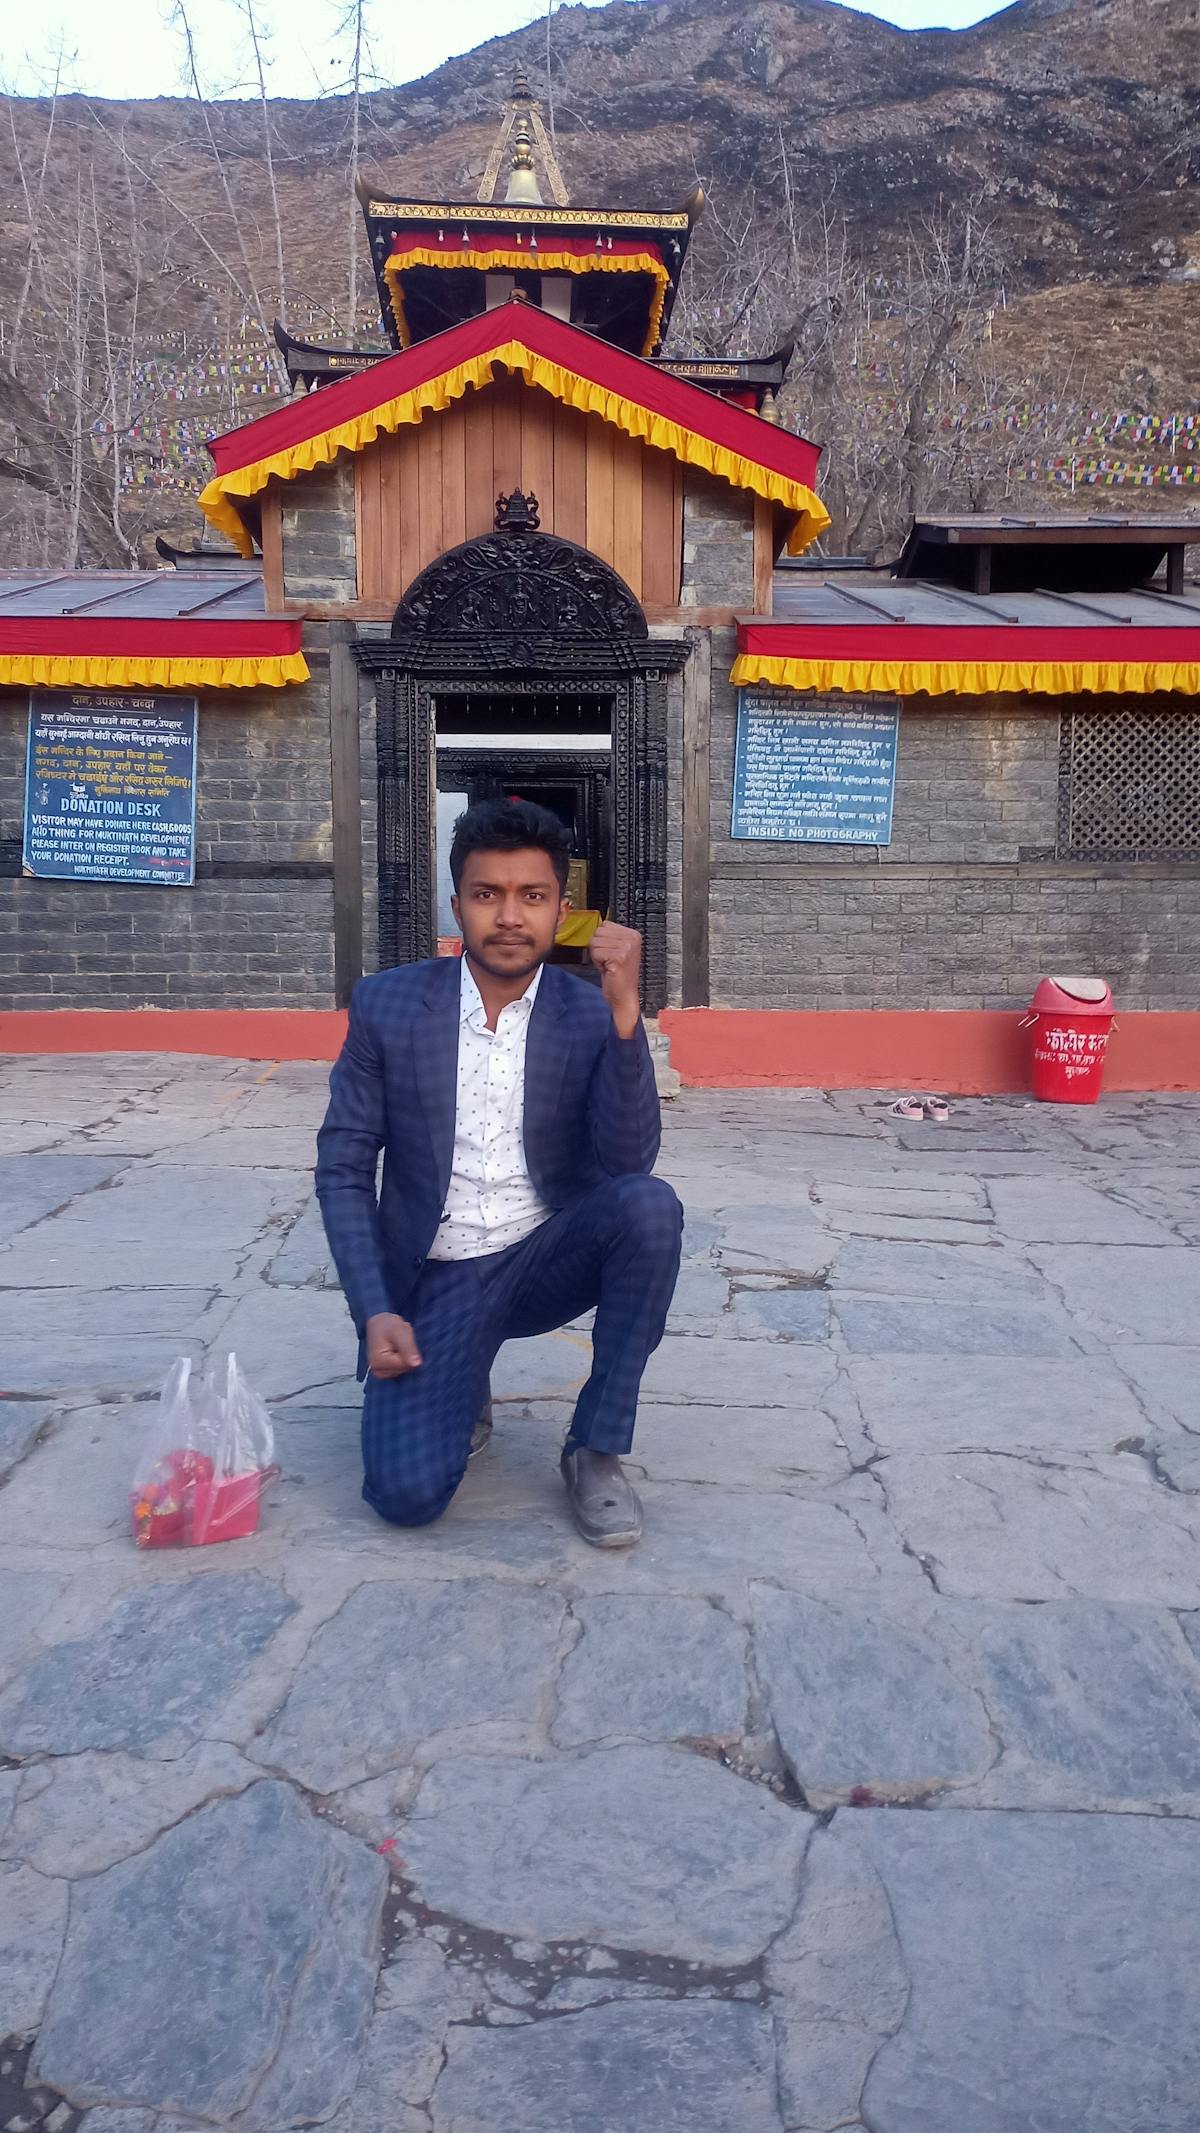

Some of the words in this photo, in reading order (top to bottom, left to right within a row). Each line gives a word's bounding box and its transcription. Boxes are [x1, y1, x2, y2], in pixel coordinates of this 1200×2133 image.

[61, 798, 124, 815] DONATION
[128, 802, 161, 817] DESK
[32, 815, 66, 826] VISITOR
[68, 817, 84, 827] MAY
[85, 818, 104, 829] HAVE
[105, 820, 131, 830] DONATE
[133, 821, 151, 830] HERE
[32, 826, 47, 837] AND
[49, 828, 76, 838] THING
[79, 830, 94, 839] FOR
[95, 831, 139, 842] MUKTINATH
[748, 827, 785, 836] INSIDE
[789, 829, 803, 837] NO
[807, 829, 878, 841] PHOTOGRAPHY
[32, 839, 59, 848] PLEASE
[61, 841, 84, 851] INTER
[85, 843, 95, 853] ON
[96, 842, 130, 854] REGISTER
[132, 845, 150, 855] BOOK
[152, 846, 167, 857] AND
[168, 847, 187, 857] TAKE
[31, 850, 52, 861] YOUR
[54, 852, 92, 863] DONATION
